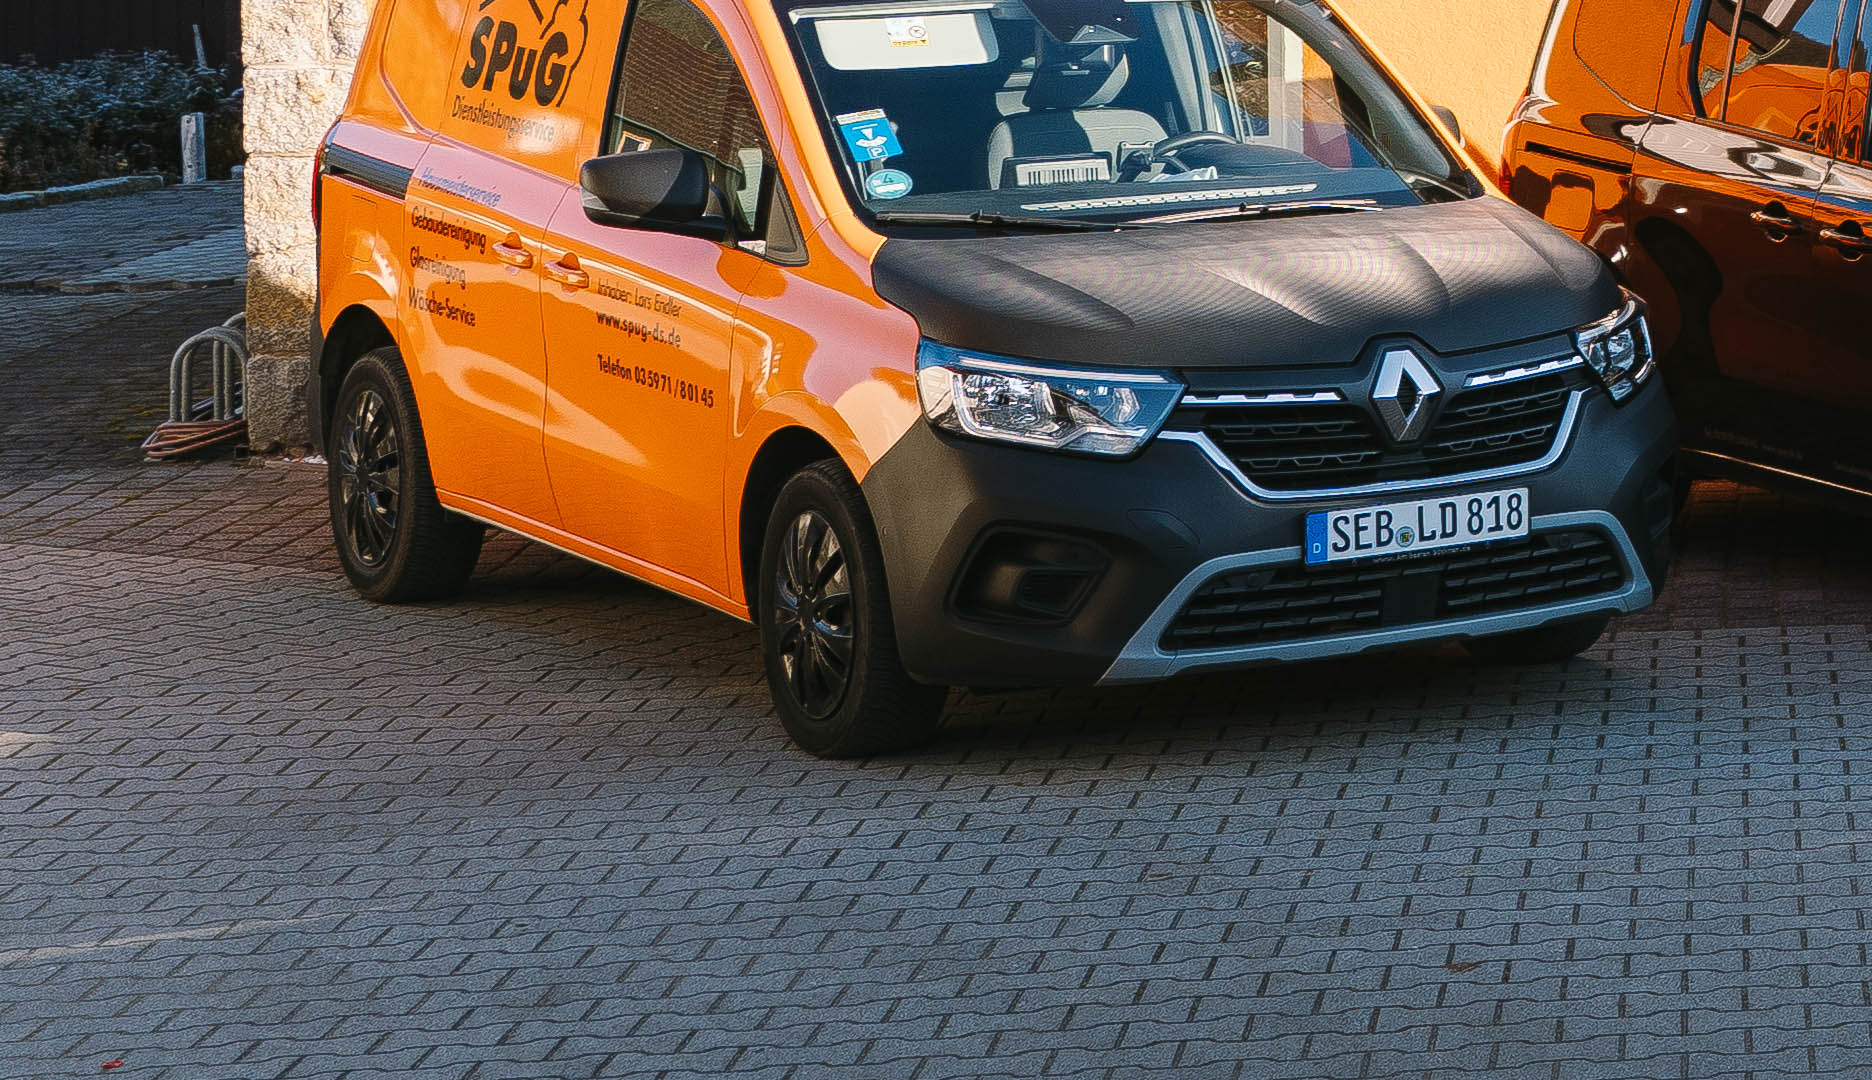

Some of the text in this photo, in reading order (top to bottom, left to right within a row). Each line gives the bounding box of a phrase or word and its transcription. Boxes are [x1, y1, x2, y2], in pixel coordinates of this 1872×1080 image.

[595, 310, 682, 348] www.spug-ds.de
[597, 353, 632, 382] Telefon
[1312, 492, 1523, 554] D SEB LD 818
